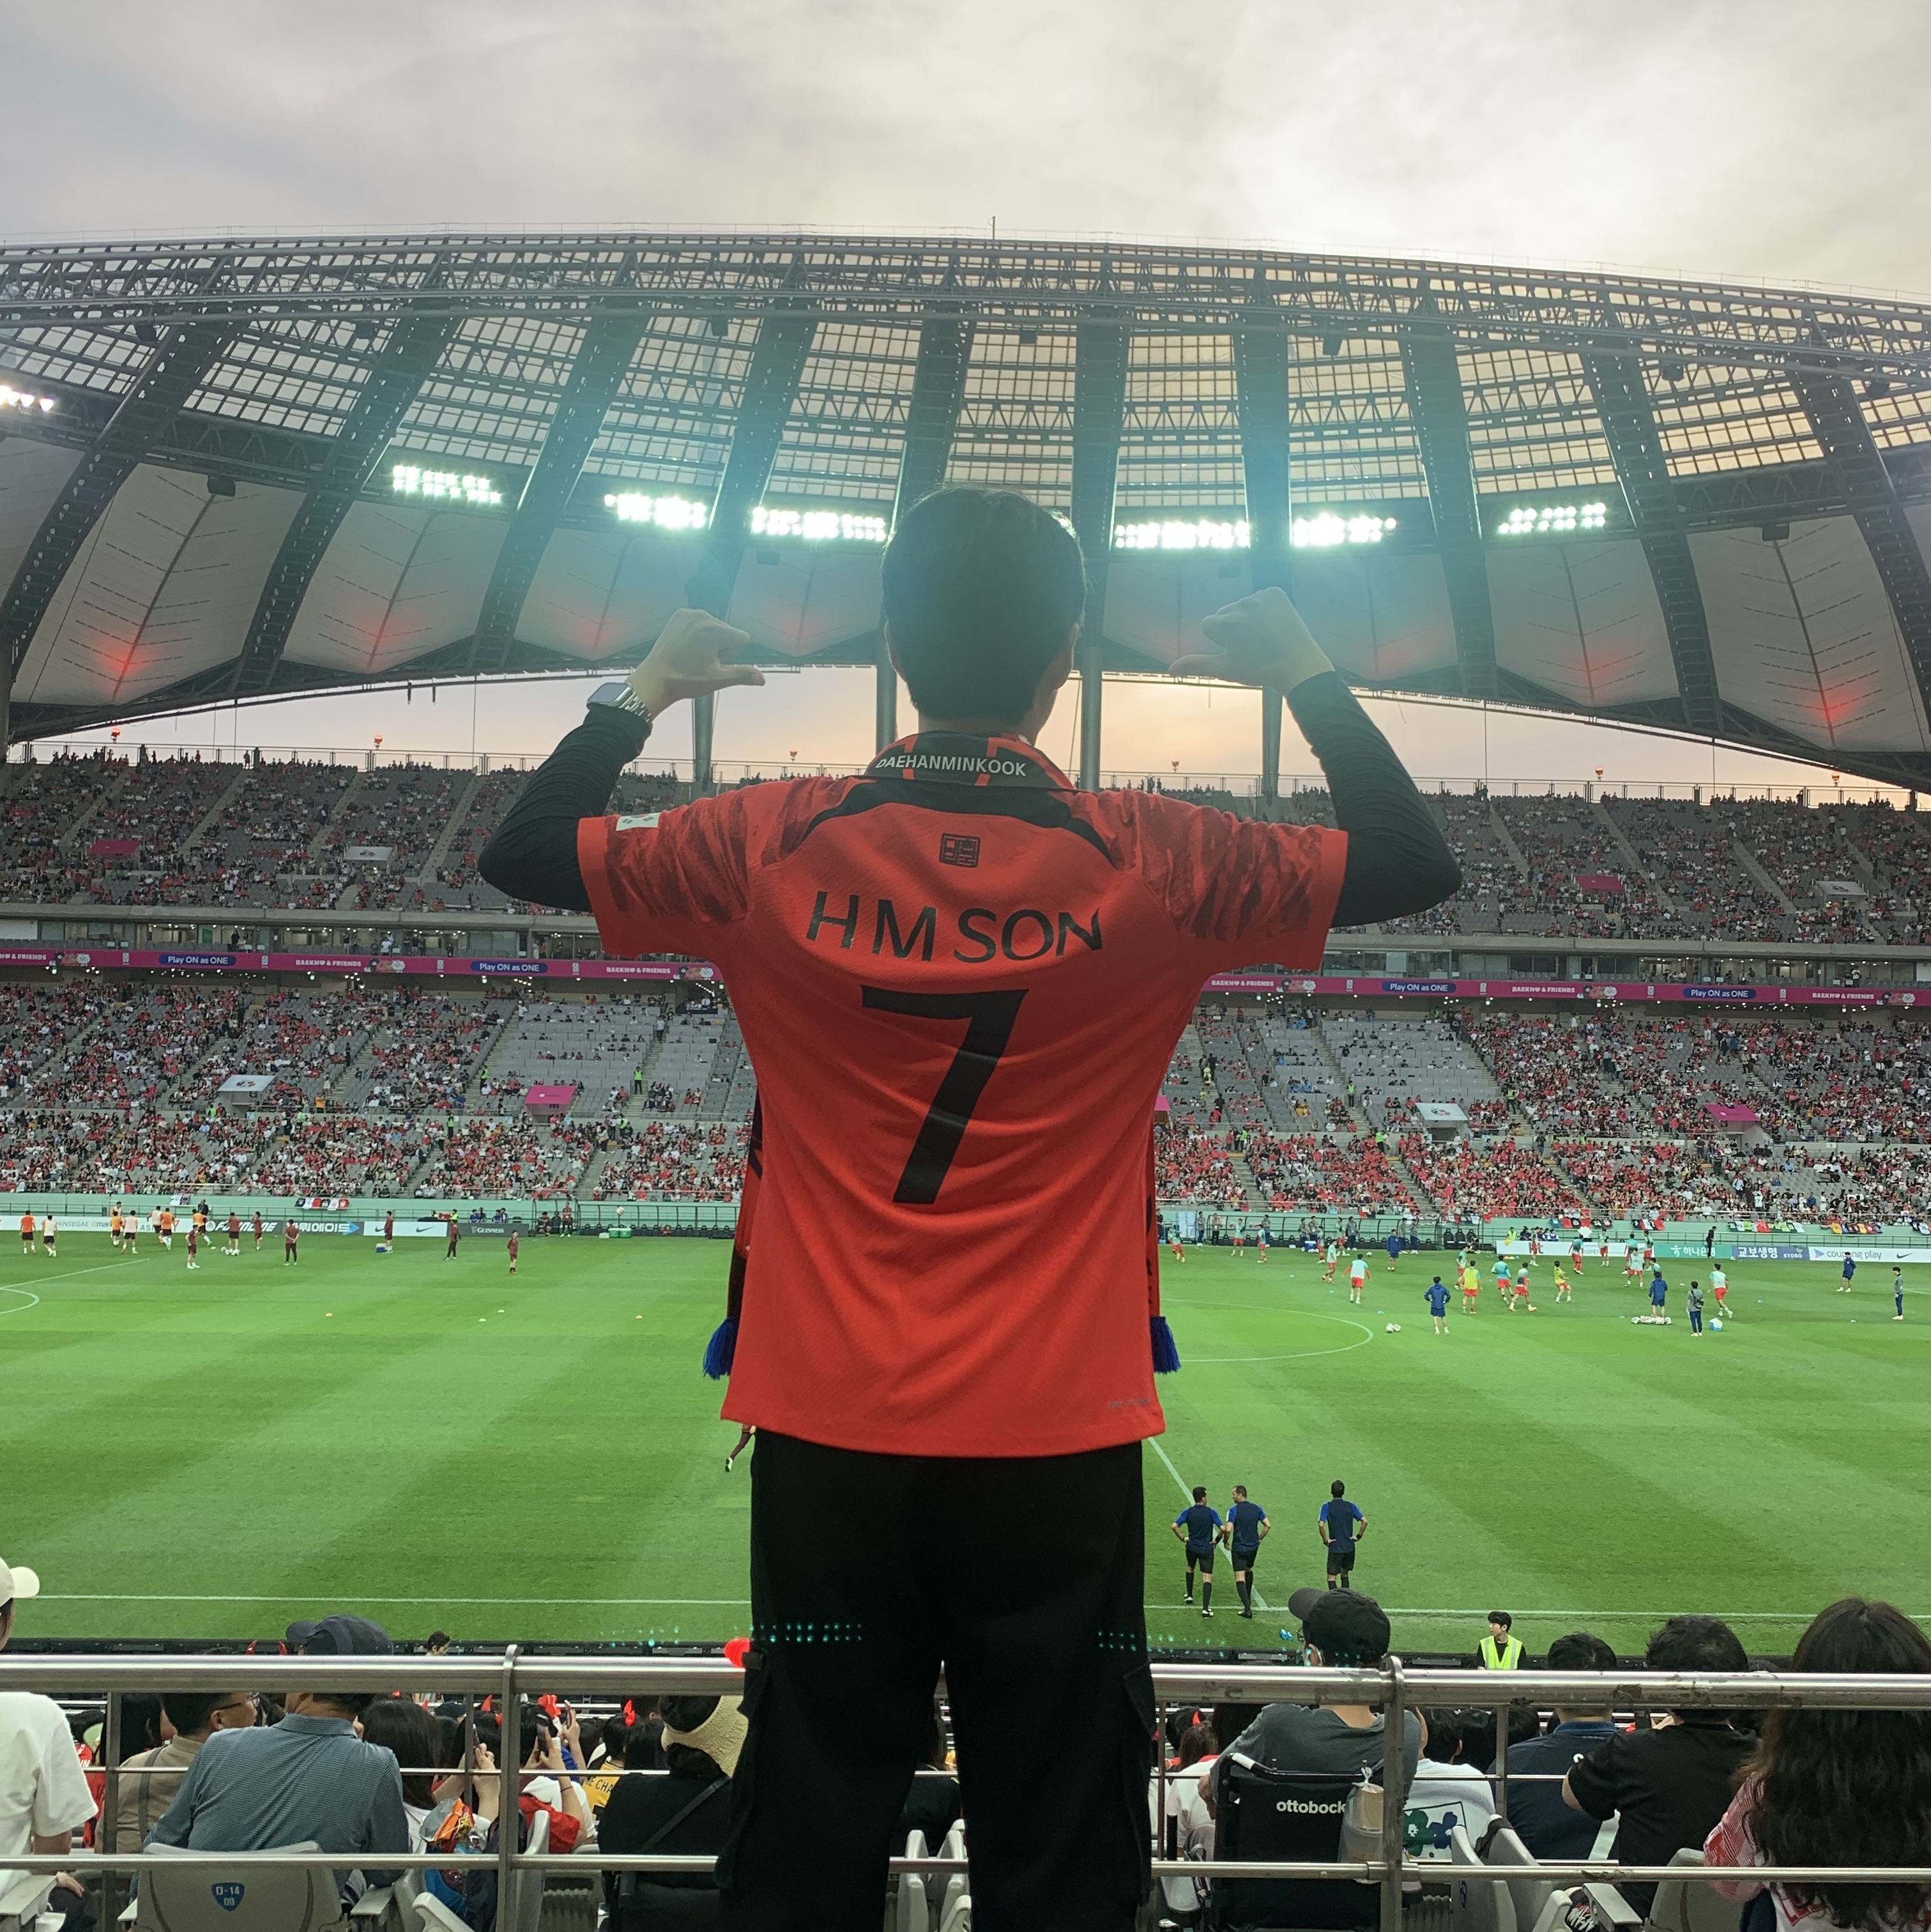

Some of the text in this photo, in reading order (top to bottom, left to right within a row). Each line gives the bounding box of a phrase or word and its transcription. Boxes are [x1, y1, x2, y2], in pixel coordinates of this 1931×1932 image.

[875, 754, 1027, 777] DAEHANMINKOOK
[954, 907, 1103, 963] SON
[168, 956, 183, 965] Play
[480, 962, 495, 971] Play
[1390, 984, 1405, 992] Play
[1691, 990, 1706, 998] Play
[860, 984, 1030, 1205] 7
[286, 1222, 351, 1233] 워에이드
[1738, 1247, 1778, 1258] 교보생명
[1827, 1250, 1882, 1260] coupng play
[595, 1779, 613, 1793] CHA
[1276, 1799, 1347, 1814] ottobock
